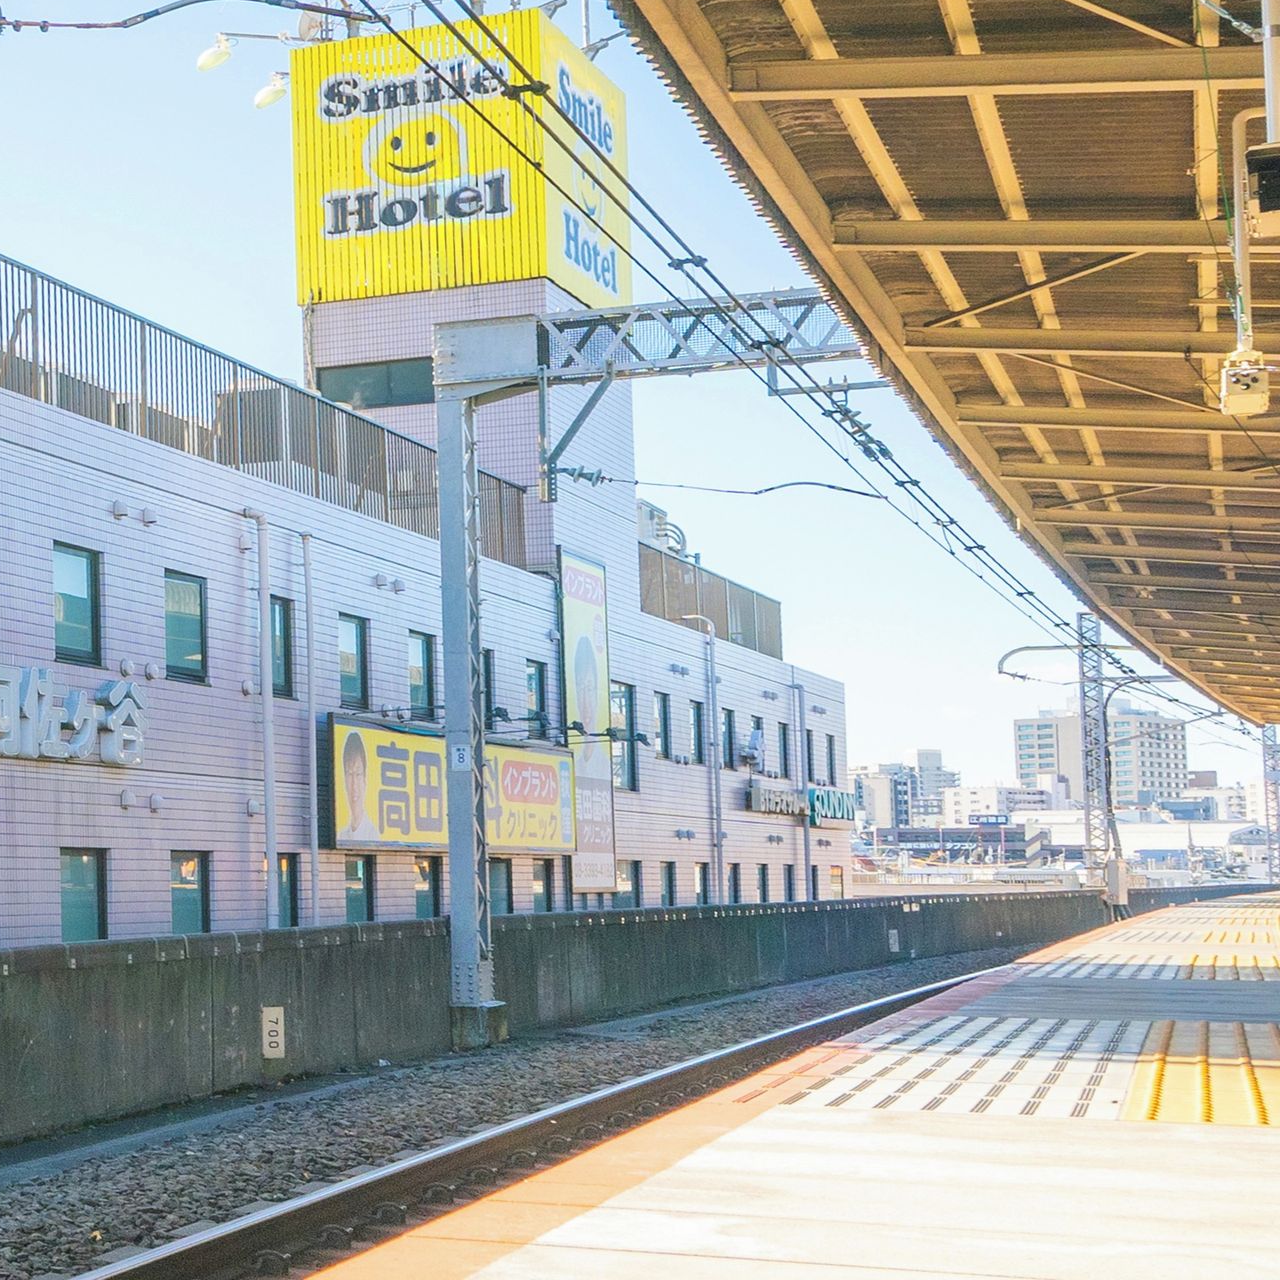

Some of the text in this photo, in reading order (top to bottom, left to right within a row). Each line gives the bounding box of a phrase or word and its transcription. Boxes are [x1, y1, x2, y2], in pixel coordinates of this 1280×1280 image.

[322, 57, 507, 118] Smile
[558, 68, 614, 154] Smile
[326, 172, 510, 236] Hotel
[562, 209, 618, 294] Hotel
[457, 752, 466, 764] 8
[504, 766, 557, 799] インプラント
[507, 809, 559, 841] クリニック
[267, 1016, 279, 1050] 700
